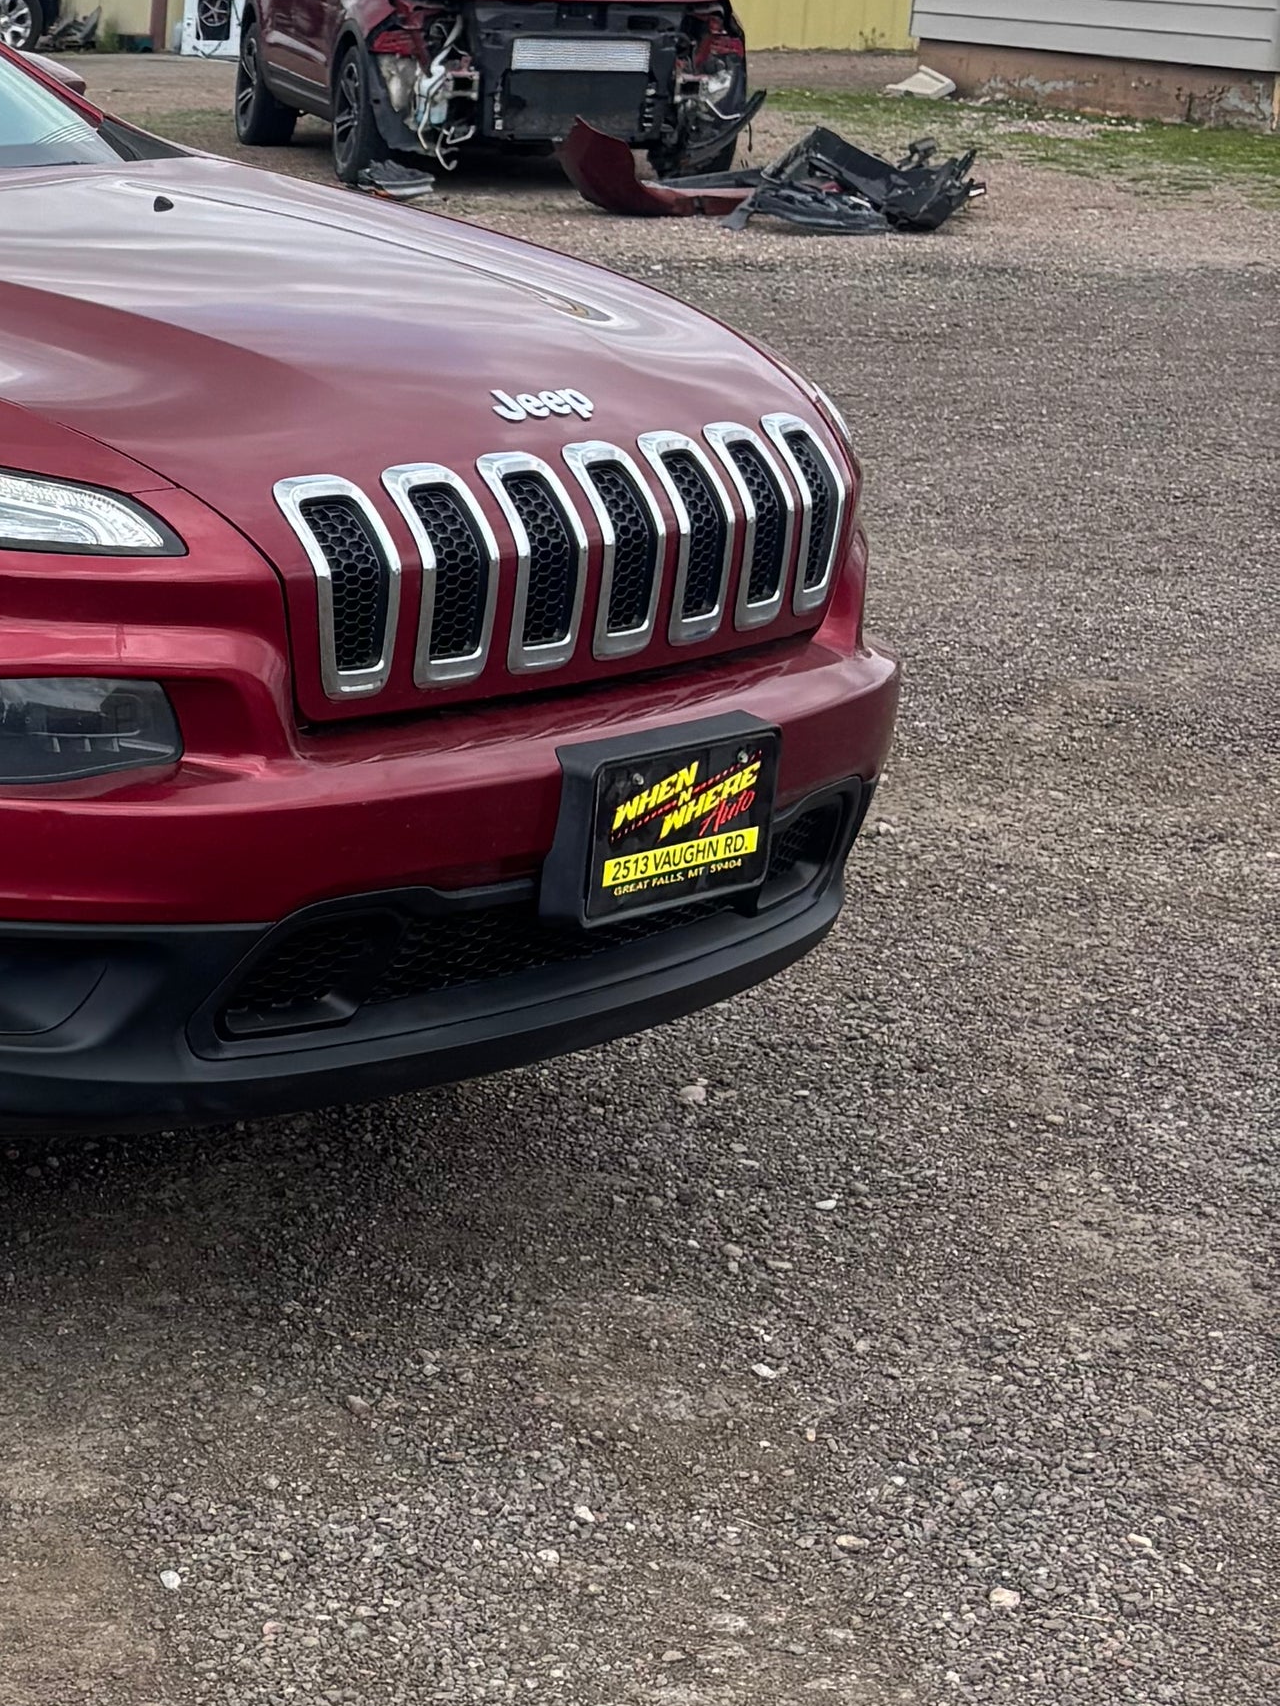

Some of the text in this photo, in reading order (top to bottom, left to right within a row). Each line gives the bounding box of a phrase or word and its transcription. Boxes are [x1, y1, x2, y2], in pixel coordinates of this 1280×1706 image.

[489, 388, 594, 422] Jeep
[611, 760, 699, 832] WHEN
[658, 760, 762, 842] WHERE
[677, 786, 693, 806] N
[698, 790, 756, 837] Auto
[611, 834, 749, 882] 2513 VAUGHN RD.
[613, 858, 743, 897] GREAT FALLS, MT 59404
